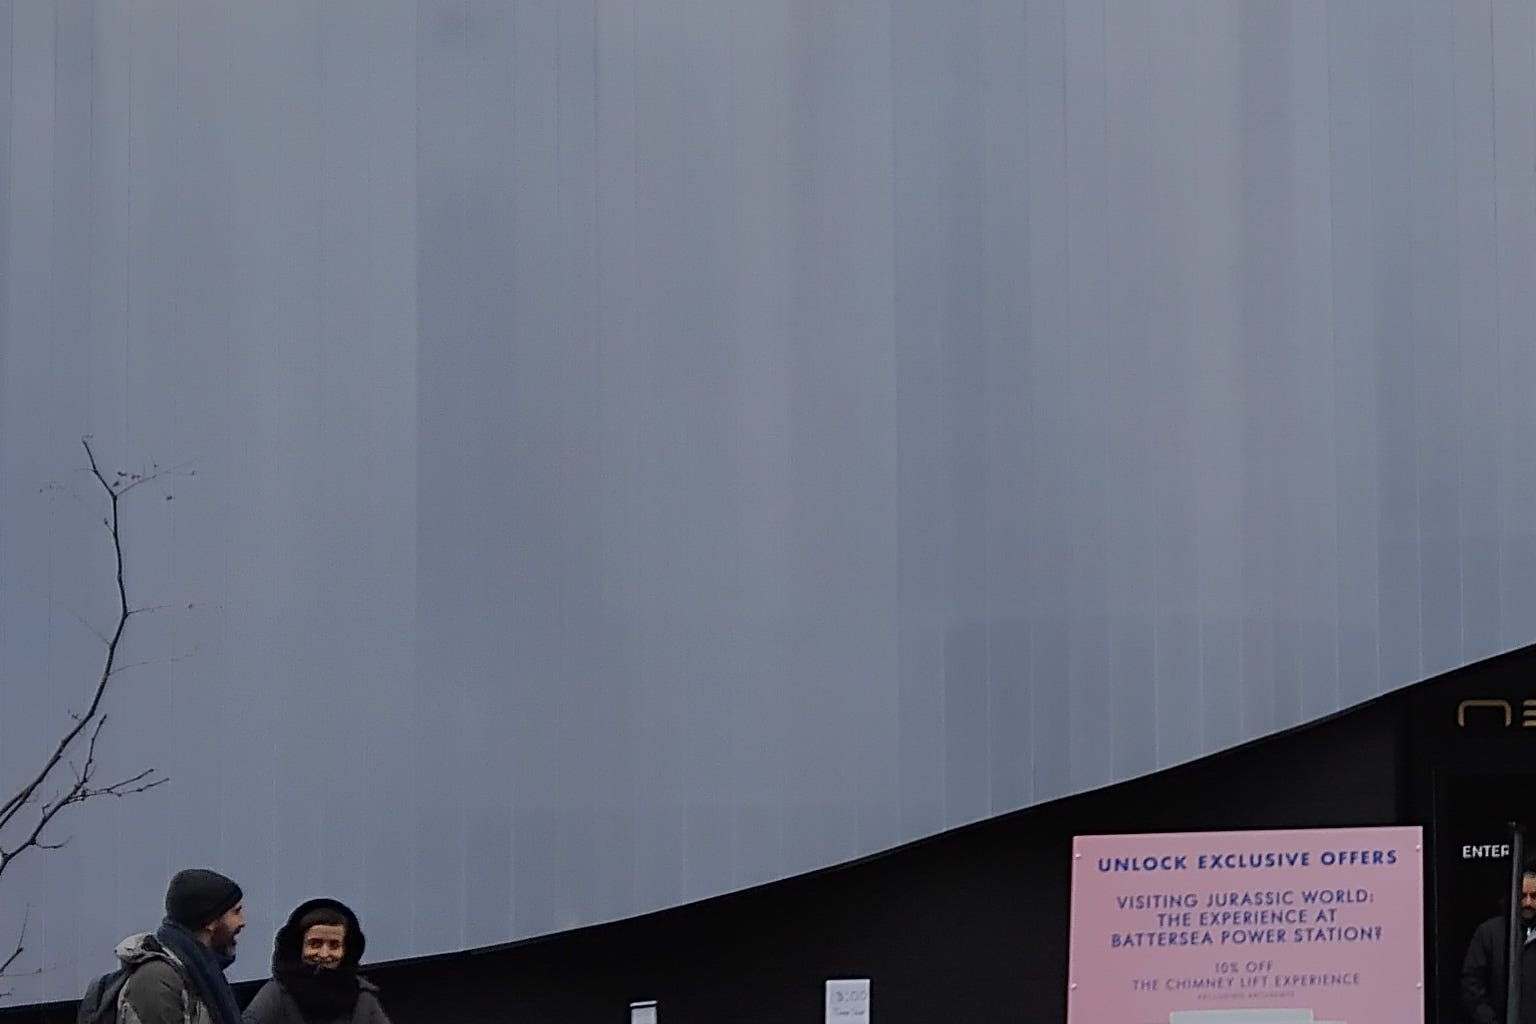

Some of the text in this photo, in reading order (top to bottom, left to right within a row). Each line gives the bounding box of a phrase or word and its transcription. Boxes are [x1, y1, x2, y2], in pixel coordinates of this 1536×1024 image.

[1098, 850, 1398, 872] UNLOCK EXCLUSIVE OFFERS
[1462, 844, 1510, 859] ENTER
[1116, 889, 1375, 910] VISITING JURASSIC WORLD:
[1157, 908, 1338, 928] THE EXPERIENCE AT
[1111, 926, 1382, 948] BATTERSEA POWER STATION?
[1215, 961, 1274, 974] 10% OFF
[1132, 973, 1361, 992] THE CHIMNEY LIFT EXPERIENCE
